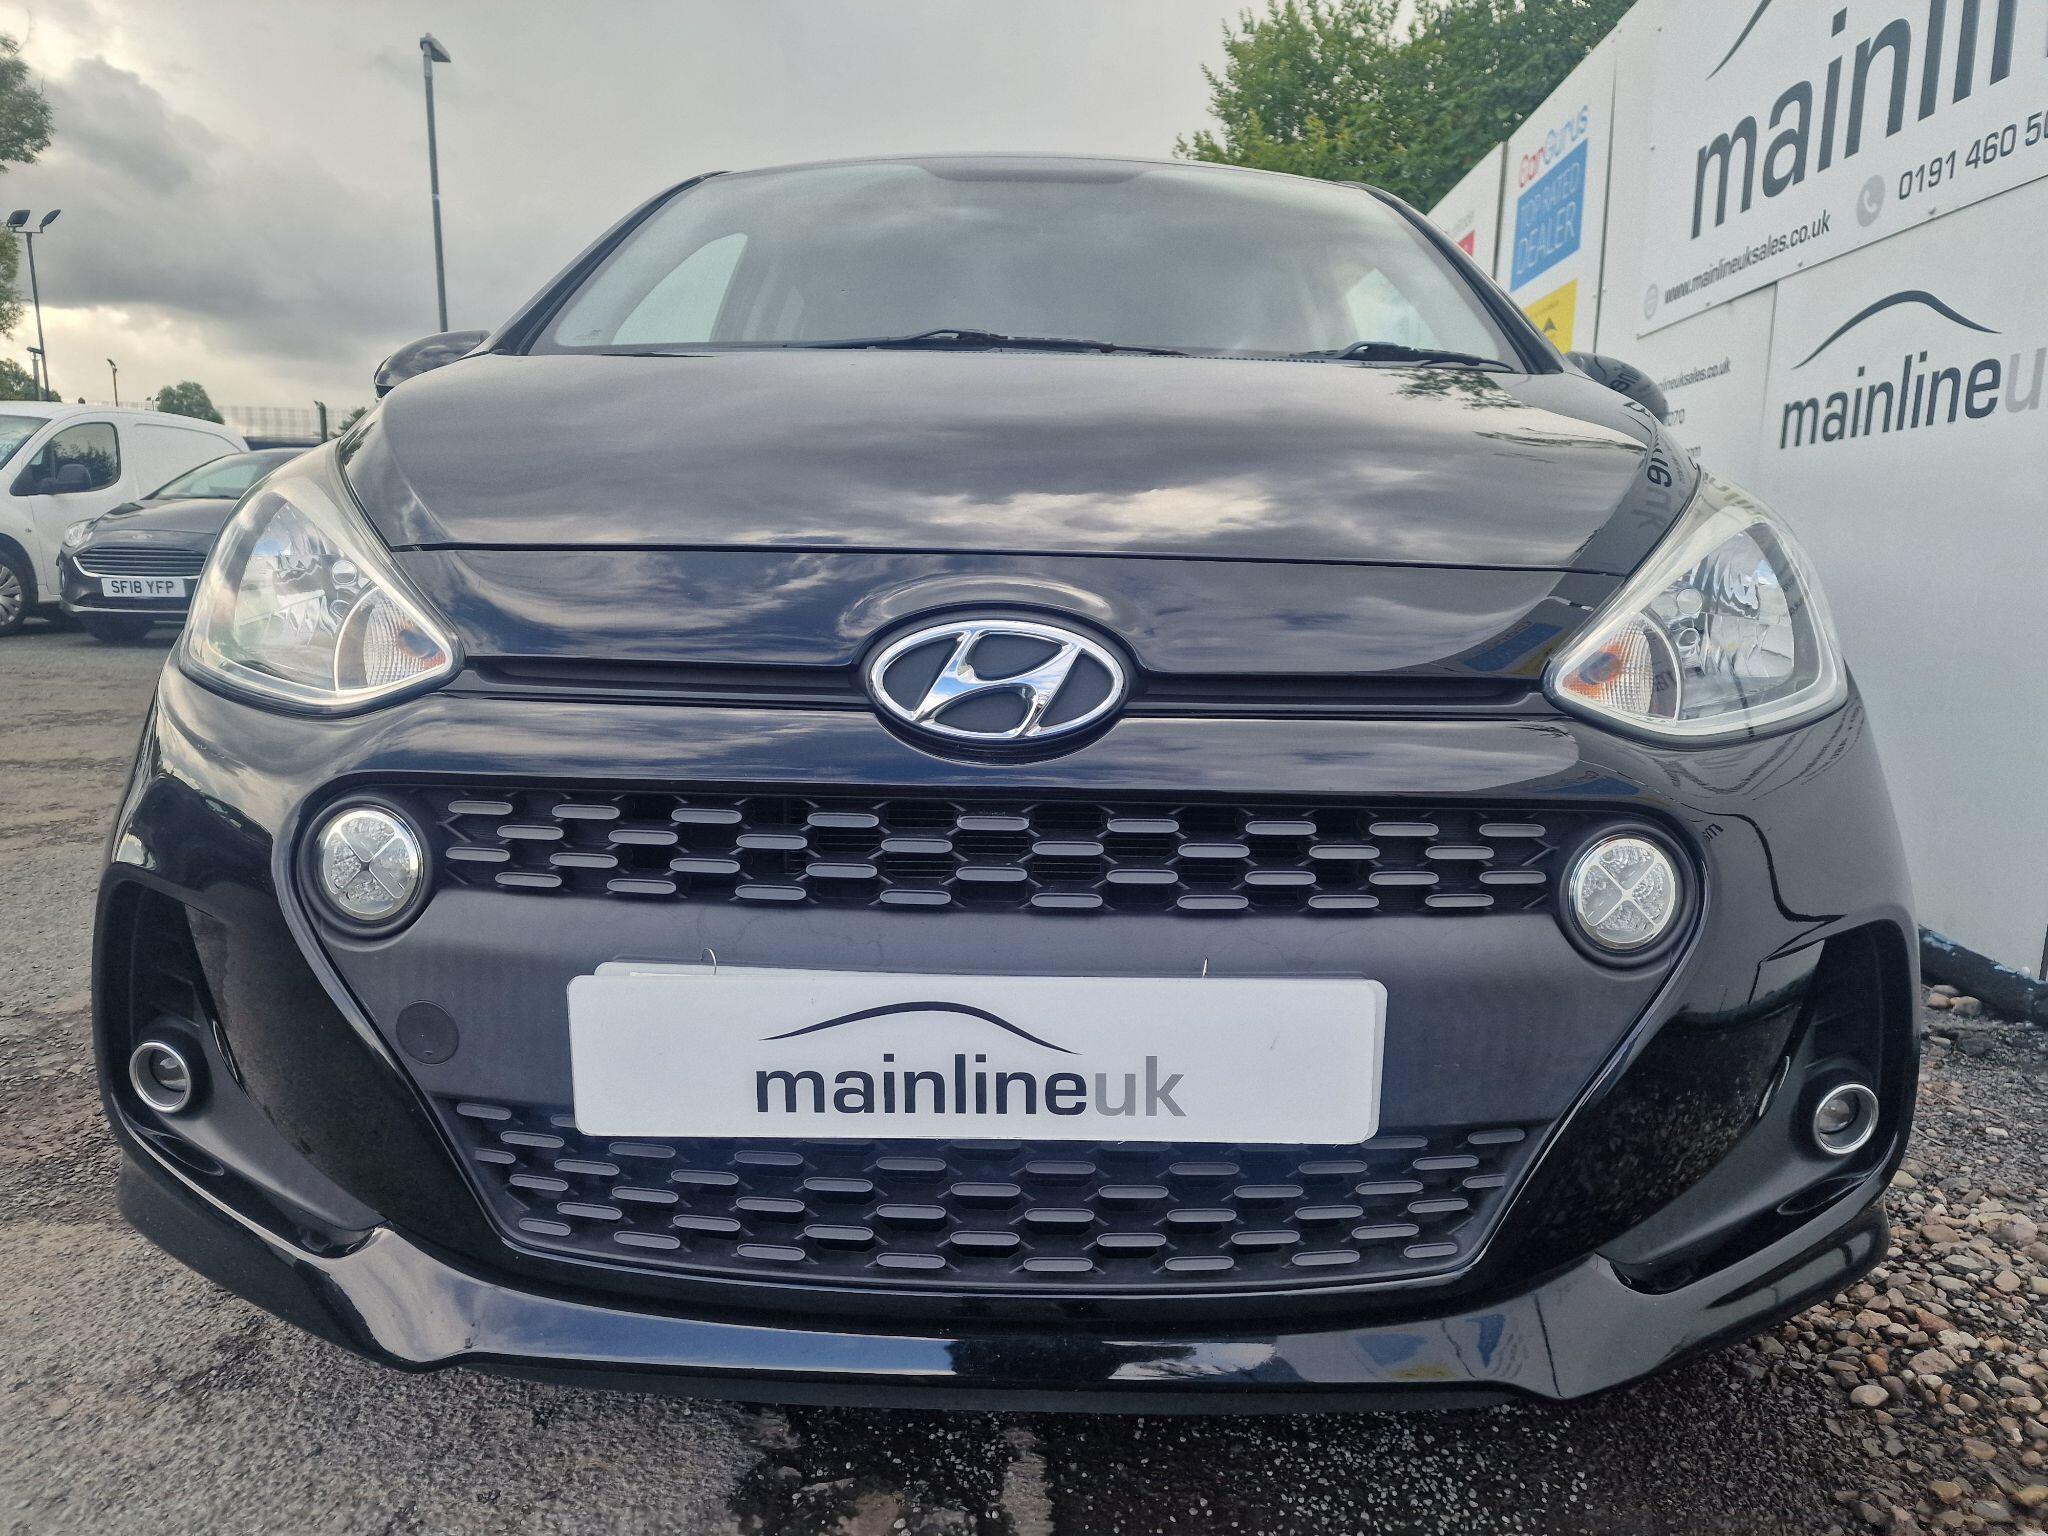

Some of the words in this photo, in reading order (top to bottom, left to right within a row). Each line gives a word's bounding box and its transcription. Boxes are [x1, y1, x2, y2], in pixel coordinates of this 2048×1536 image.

[1899, 150, 1956, 200] 0191
[1965, 123, 2017, 169] 460
[2025, 110, 2048, 147] 5
[1515, 201, 1577, 275] DEALER
[1664, 208, 1831, 304] www.mainlineuksales.co.uk
[1779, 347, 2048, 450] mainlineu
[111, 580, 142, 594] SF18
[146, 580, 174, 594] YFP
[756, 1053, 1187, 1117] mainlineuk
